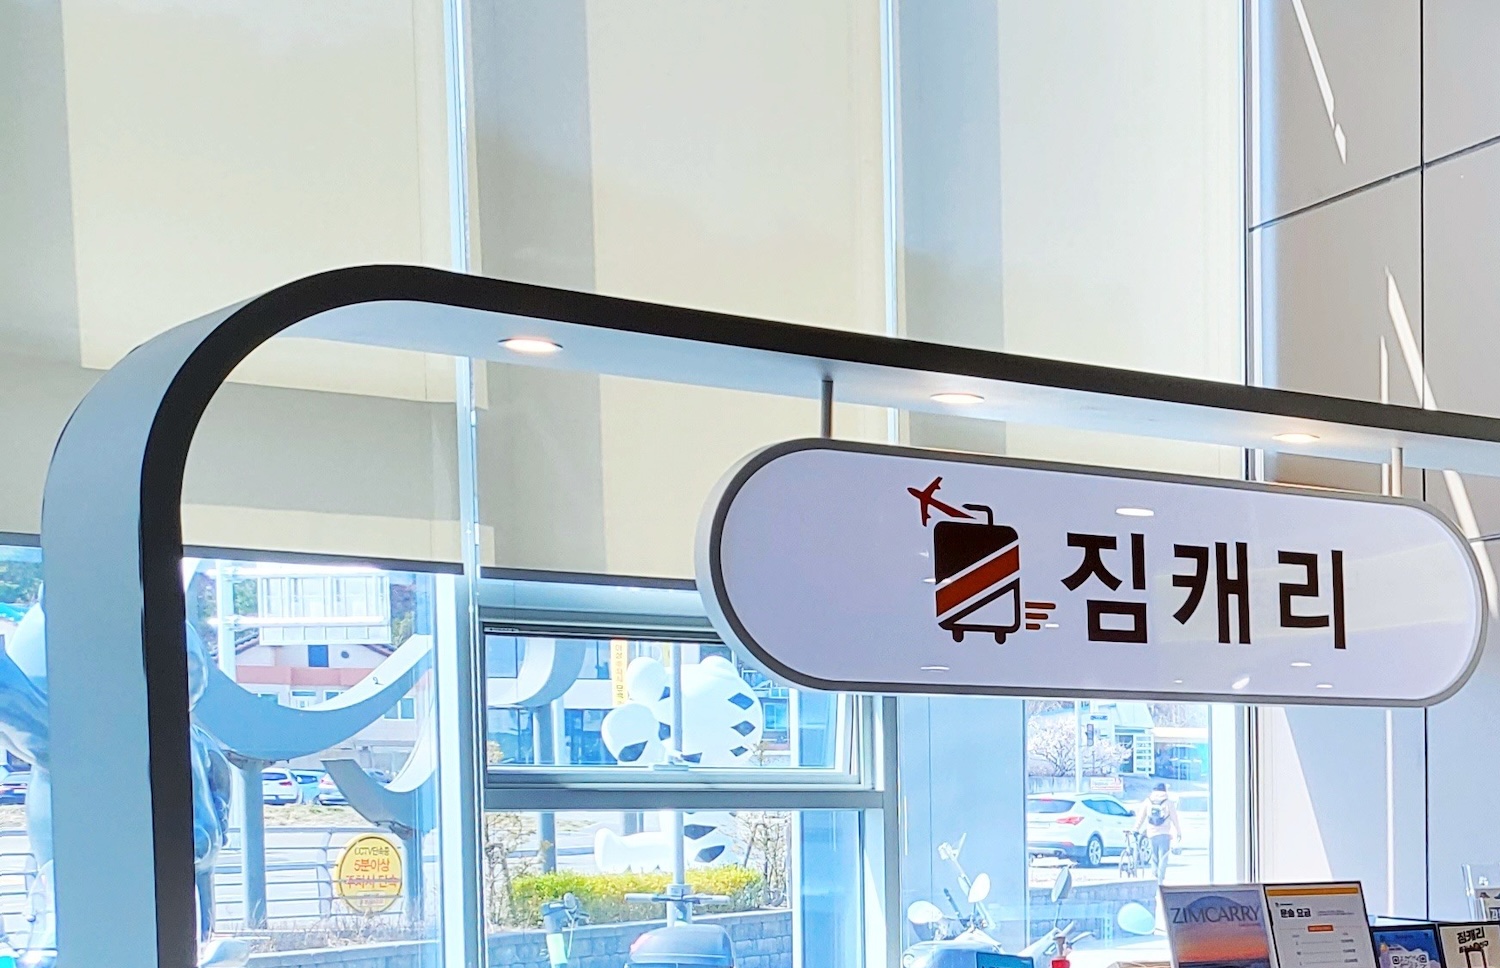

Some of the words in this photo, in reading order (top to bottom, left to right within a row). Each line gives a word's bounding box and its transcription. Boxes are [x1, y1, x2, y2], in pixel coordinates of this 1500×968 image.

[1061, 532, 1347, 650] 짐캐리
[354, 858, 390, 872] 5분이상
[1170, 905, 1260, 924] ZIMCARRY
[1457, 926, 1485, 944] 짐캐리
